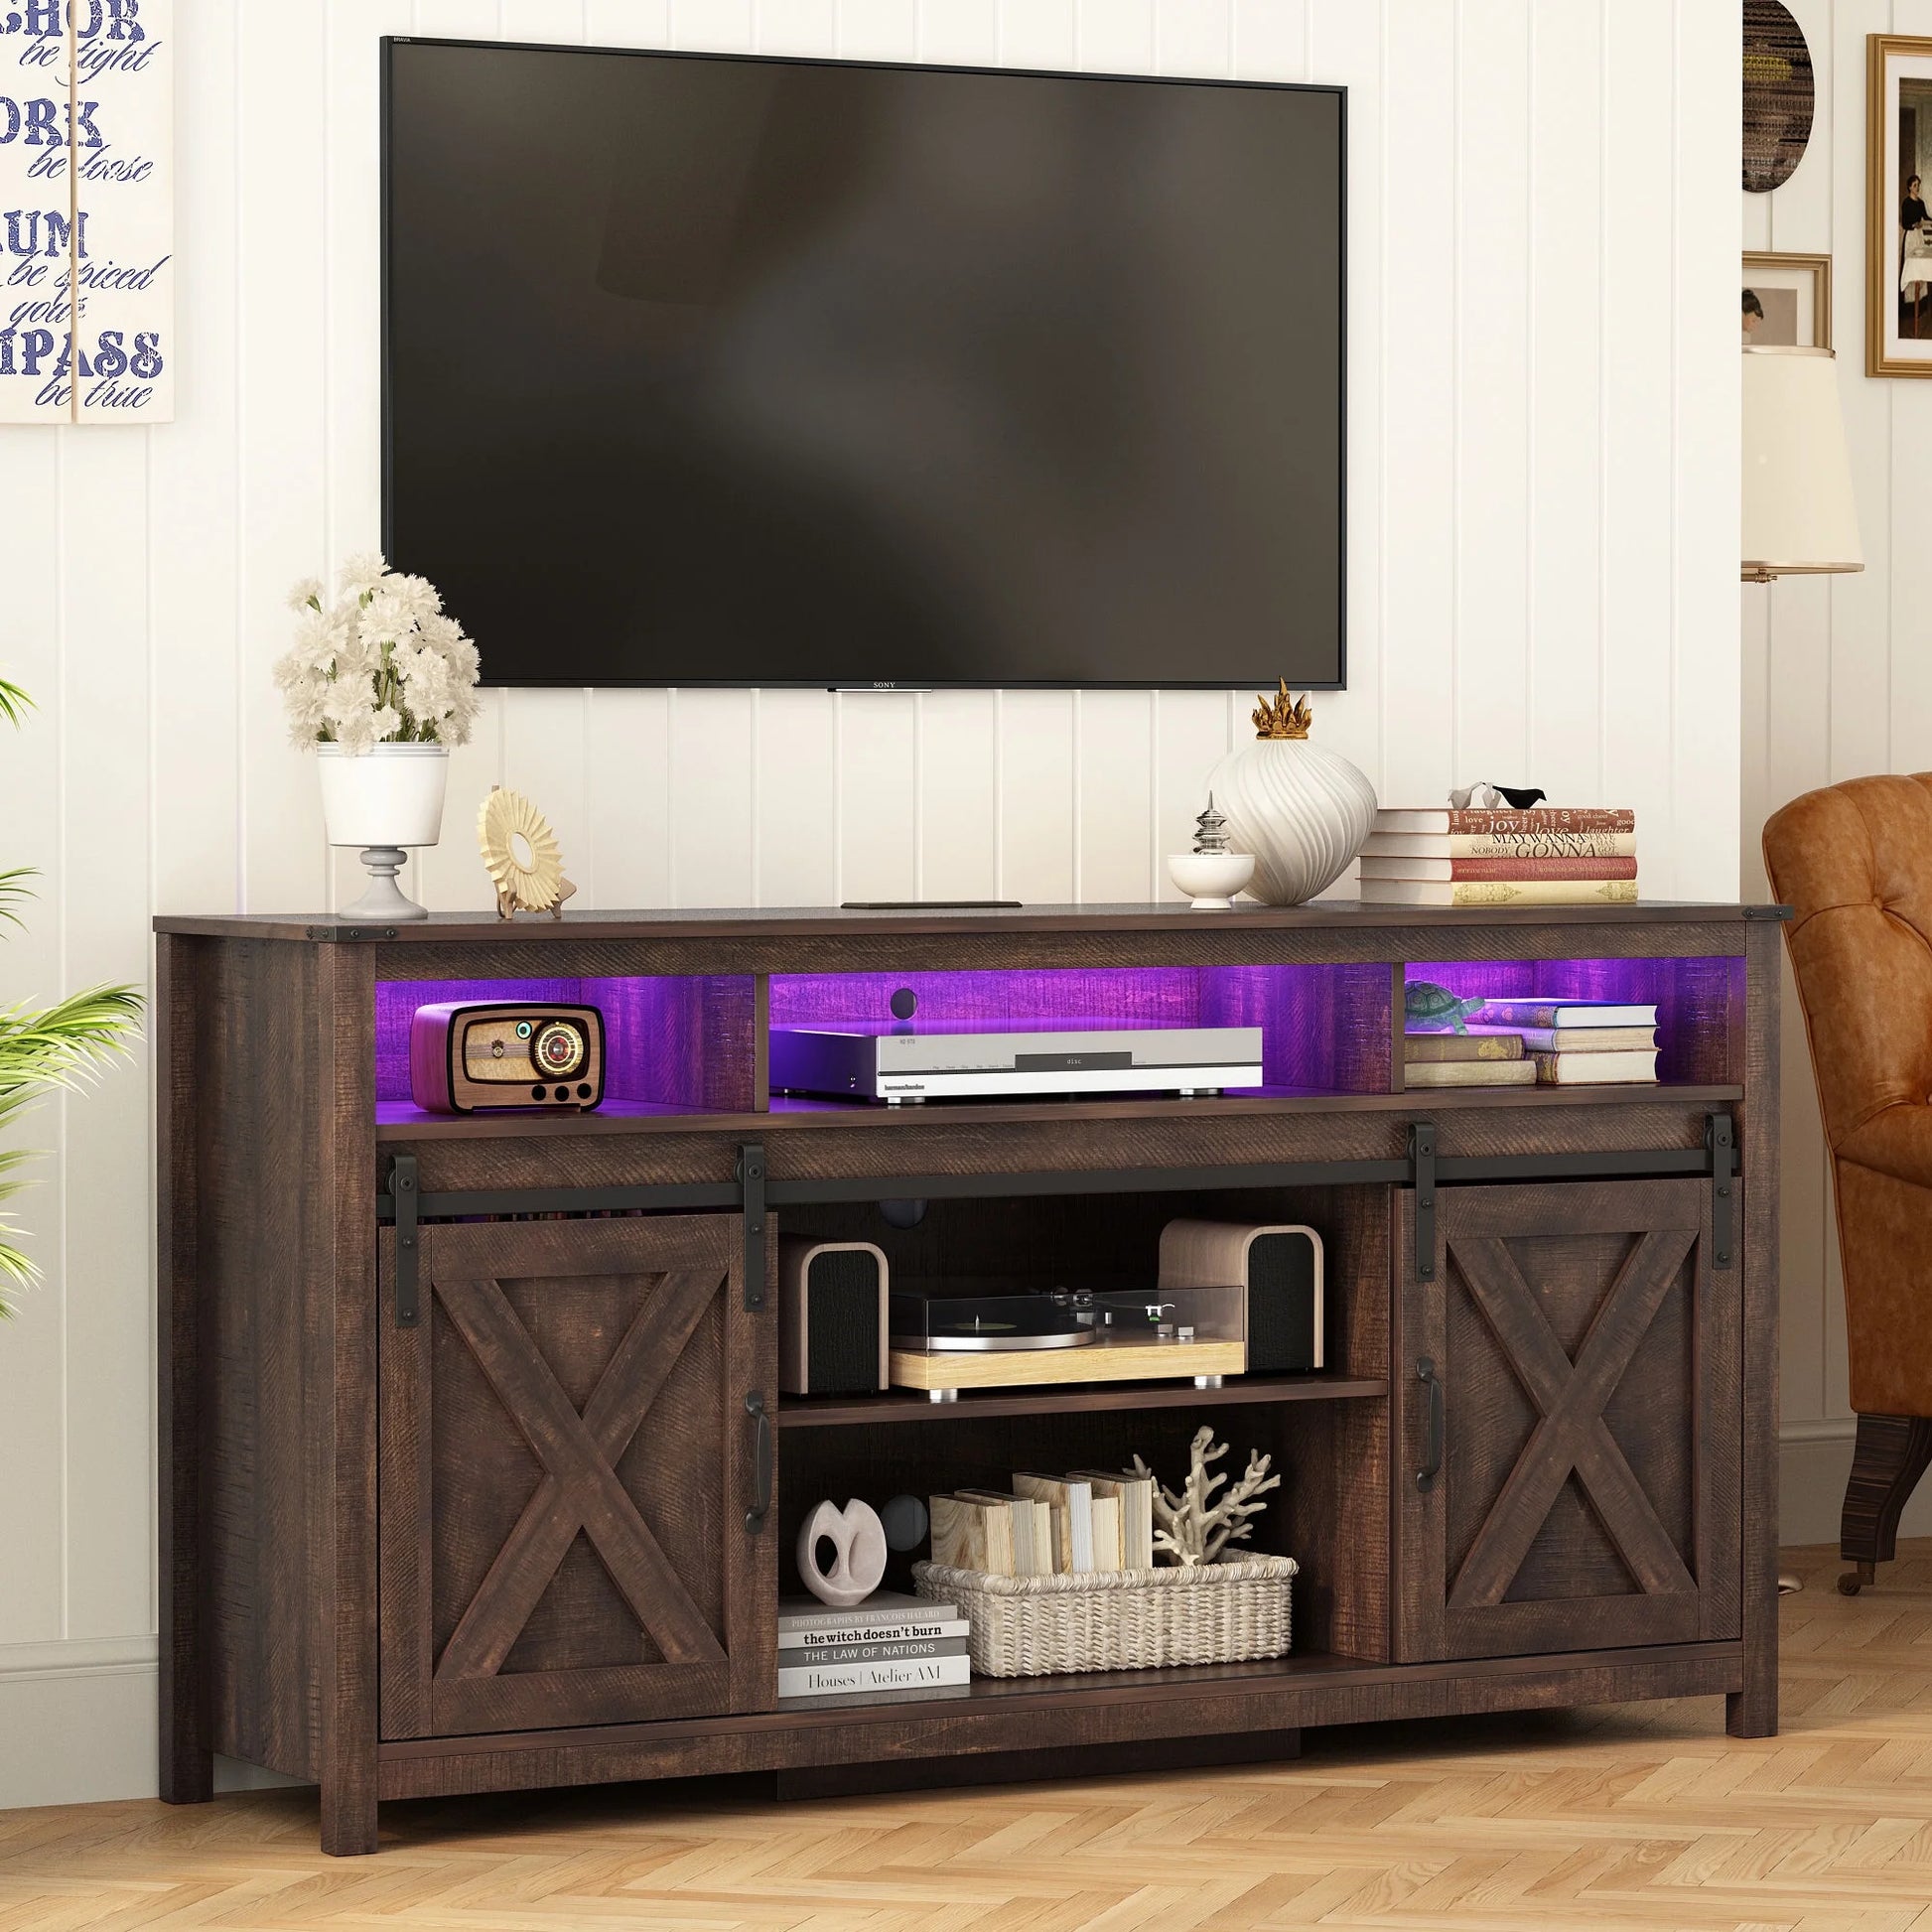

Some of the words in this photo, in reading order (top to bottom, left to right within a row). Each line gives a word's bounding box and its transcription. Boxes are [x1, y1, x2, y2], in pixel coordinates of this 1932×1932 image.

[20, 34, 60, 67] be
[27, 144, 67, 178] be
[77, 145, 154, 182] loose
[7, 250, 49, 286] be
[35, 374, 72, 406] be
[84, 377, 154, 408] true
[1489, 816, 1520, 834] joy
[1515, 843, 1596, 858] GONNA
[804, 1633, 824, 1645] the
[826, 1629, 862, 1644] witch
[912, 1625, 942, 1637] burn
[804, 1652, 828, 1661] THE
[833, 1649, 858, 1660] LAW
[863, 1647, 879, 1657] OF
[883, 1643, 935, 1656] NATIONS
[808, 1674, 856, 1689] Houses
[871, 1669, 912, 1684] Atelier
